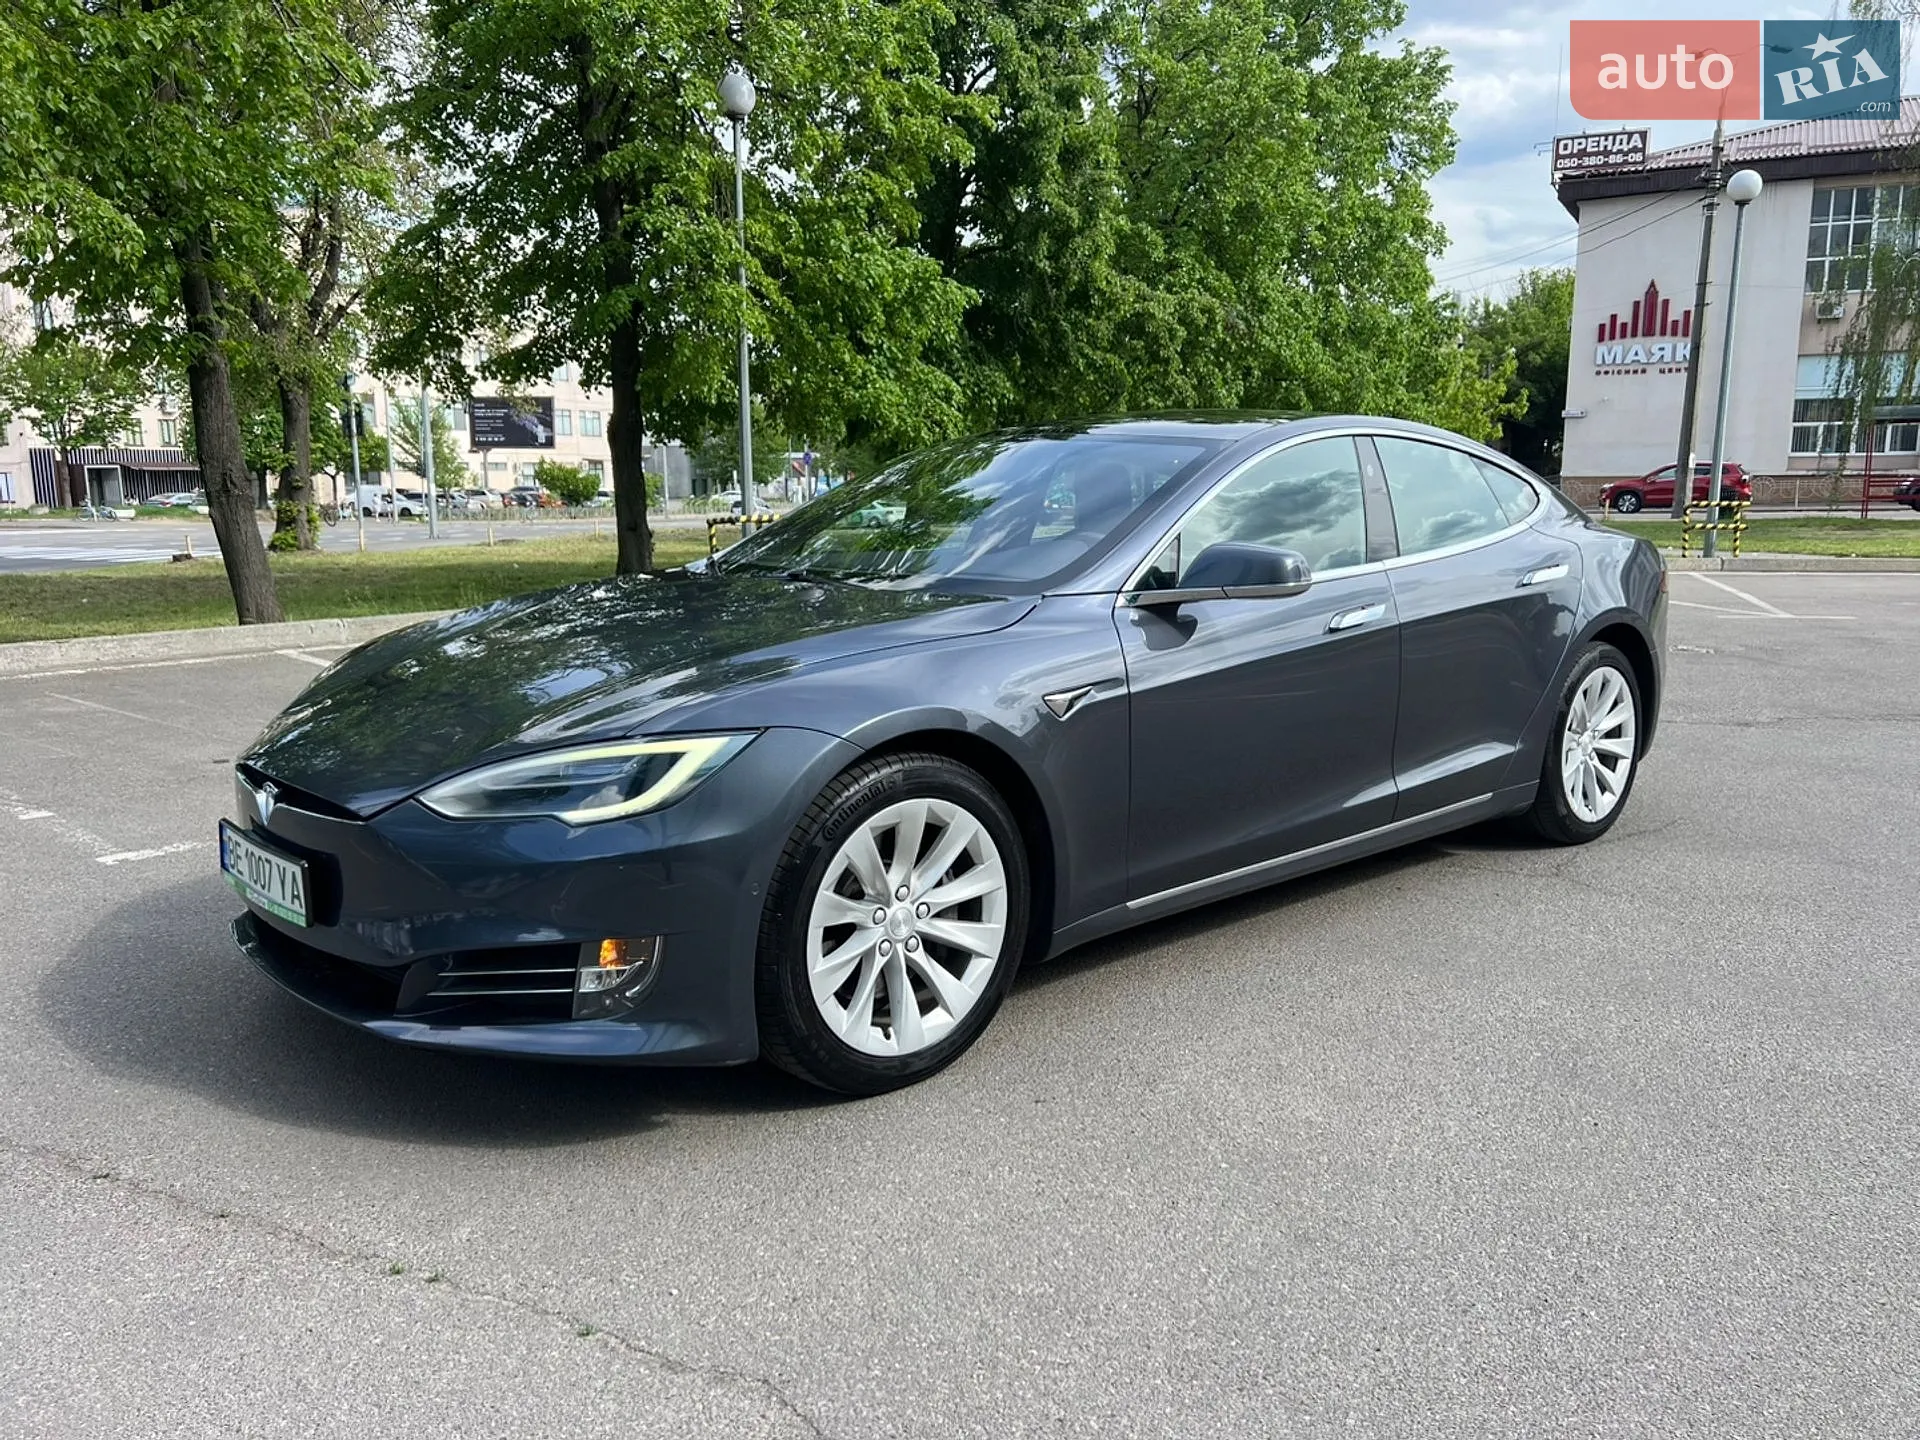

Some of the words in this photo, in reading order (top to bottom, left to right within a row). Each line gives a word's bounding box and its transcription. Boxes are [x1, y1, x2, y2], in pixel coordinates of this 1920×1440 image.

[1558, 133, 1643, 155] ОРЕНДА
[1595, 342, 1691, 365] МАЯК
[822, 779, 886, 842] Continental
[228, 835, 244, 877] BE
[245, 847, 272, 894] 1007
[275, 862, 303, 909] YA
